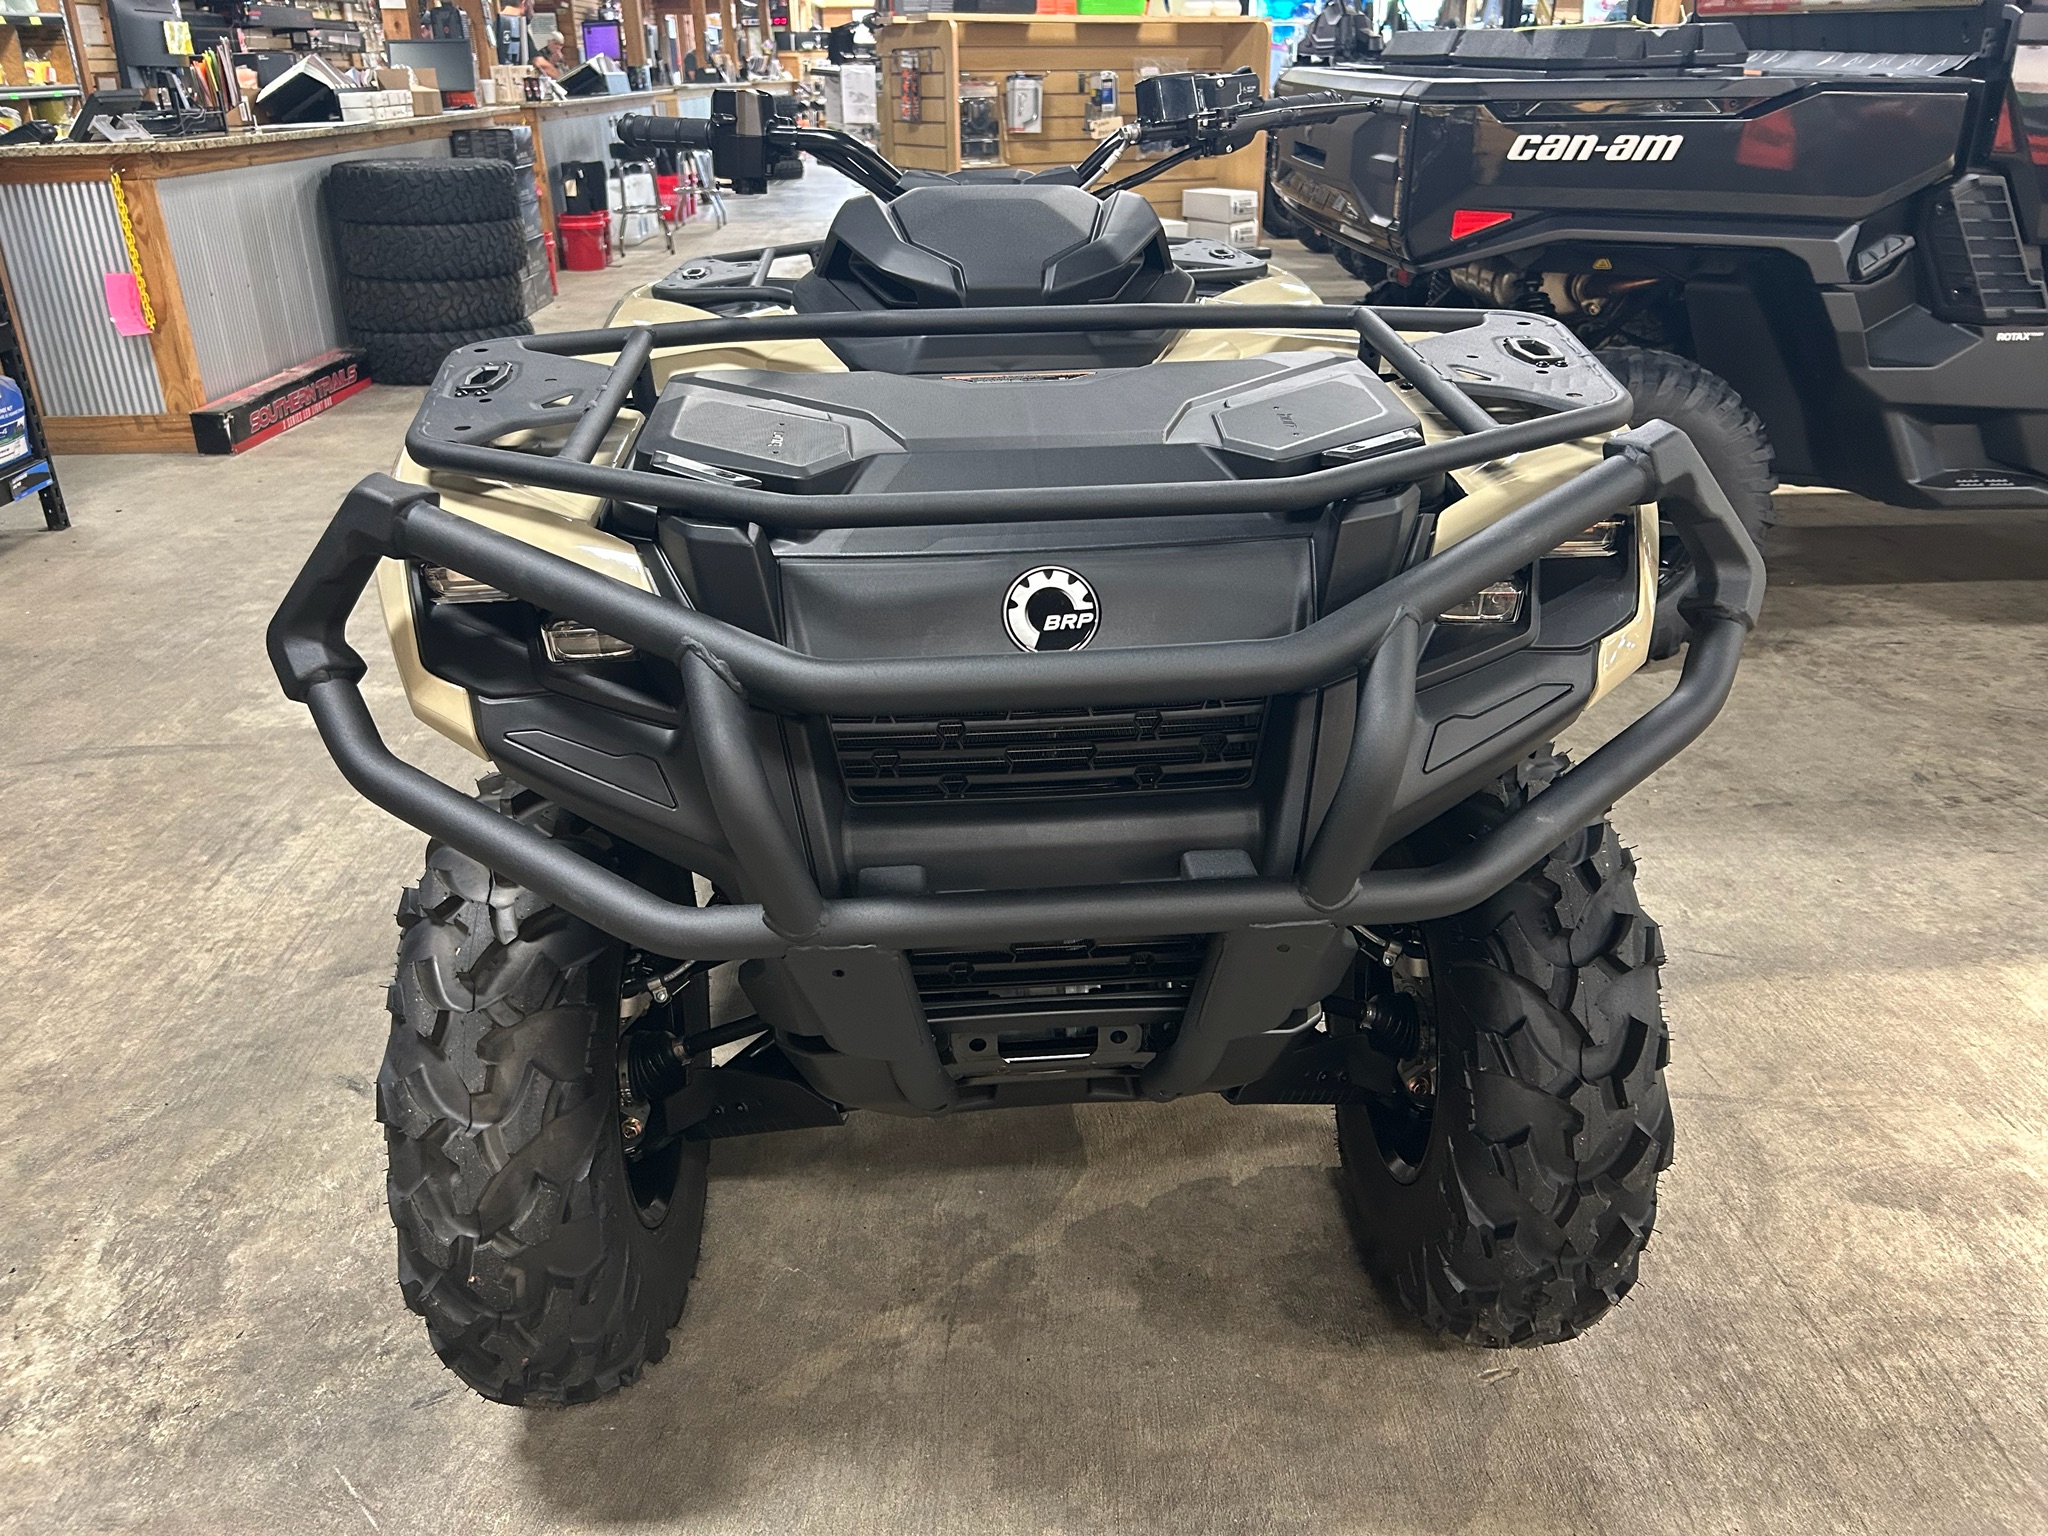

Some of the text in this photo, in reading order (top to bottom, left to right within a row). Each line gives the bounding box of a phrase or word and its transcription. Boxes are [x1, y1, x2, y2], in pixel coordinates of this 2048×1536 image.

[1506, 134, 1685, 161] can-am
[1996, 332, 2030, 341] ROTAX
[249, 363, 358, 434] SOUTHERN TRAILS
[1043, 612, 1094, 631] BRP
